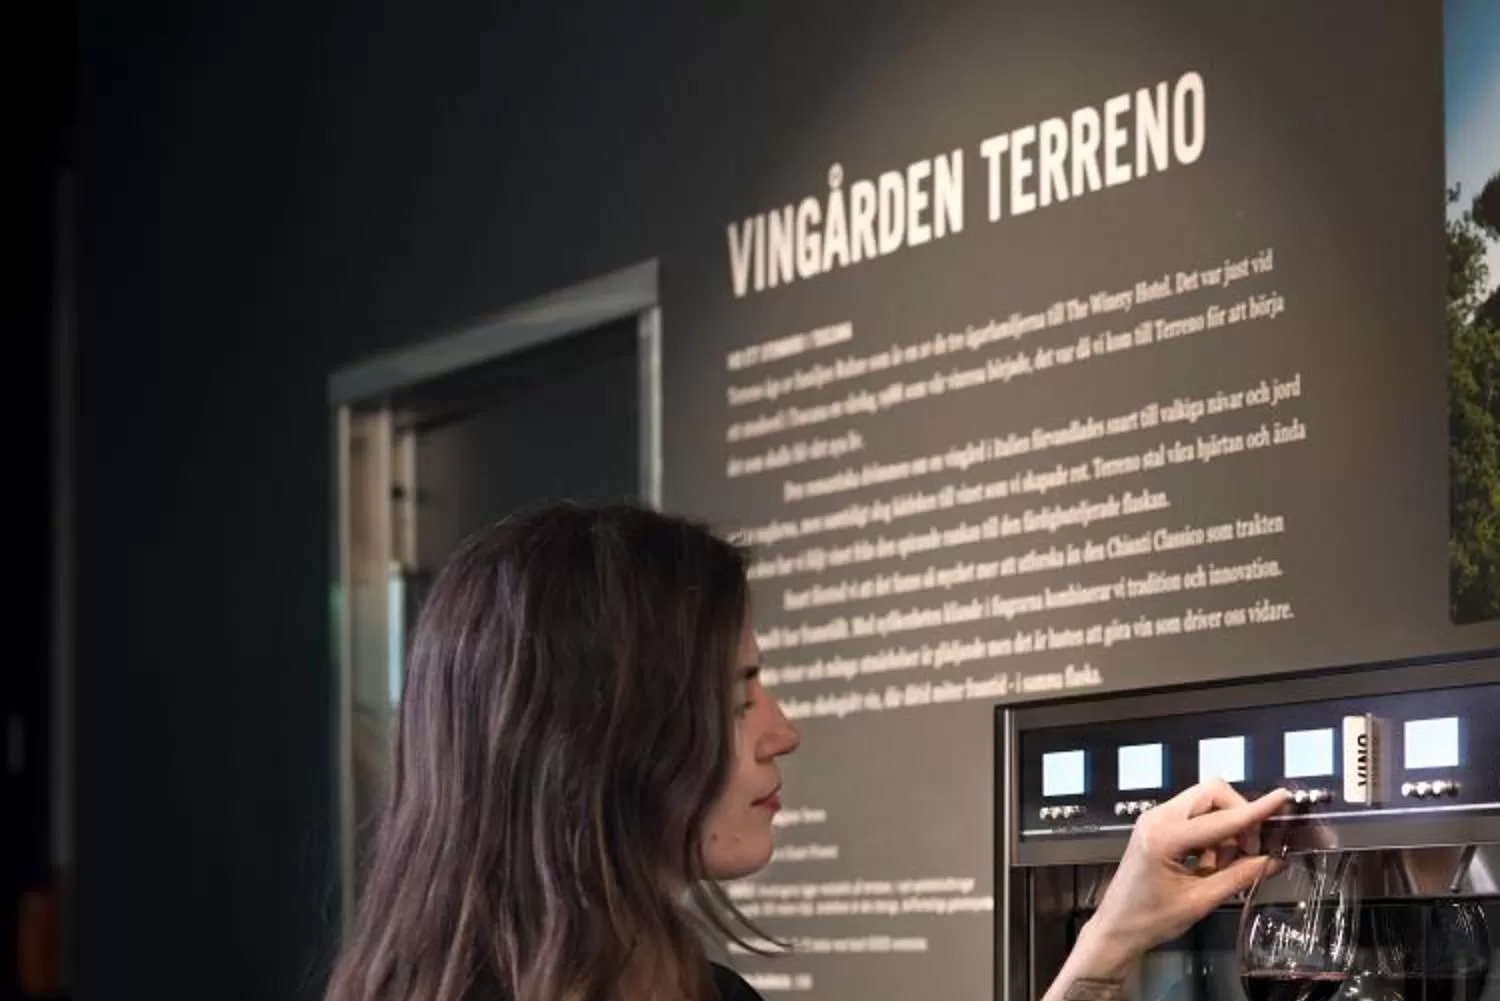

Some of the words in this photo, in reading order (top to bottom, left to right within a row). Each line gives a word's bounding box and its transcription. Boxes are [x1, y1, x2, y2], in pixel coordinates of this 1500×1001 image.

[727, 148, 964, 298] VINGÅRDEN
[980, 71, 1205, 223] TERRENO
[1067, 297, 1088, 321] The
[1090, 291, 1133, 314] Winery
[1135, 274, 1172, 304] Hotel.
[1176, 269, 1199, 294] Det
[1201, 266, 1222, 286] var
[1223, 257, 1249, 288] just
[1251, 247, 1273, 273] vid
[1155, 314, 1204, 341] Terreno
[1206, 303, 1226, 329] för
[1228, 302, 1247, 322] att
[1249, 290, 1285, 320] börja
[1245, 380, 1271, 406] och
[1271, 373, 1301, 406] jord
[1093, 455, 1140, 479] Terreno
[1142, 443, 1165, 469] stal
[1167, 440, 1195, 463] våra
[1197, 434, 1243, 462] hjärtan
[1245, 425, 1271, 450] och
[1273, 418, 1307, 444] ända
[1153, 524, 1205, 552] Classico
[1206, 524, 1233, 544] som
[1235, 512, 1284, 539] trakten
[1128, 570, 1181, 596] tradition
[1184, 563, 1207, 589] och
[1209, 557, 1283, 586] innovation.
[1156, 616, 1181, 636] som
[1183, 608, 1222, 633] driver
[1224, 609, 1246, 627] oss
[1248, 599, 1295, 625] vidare.
